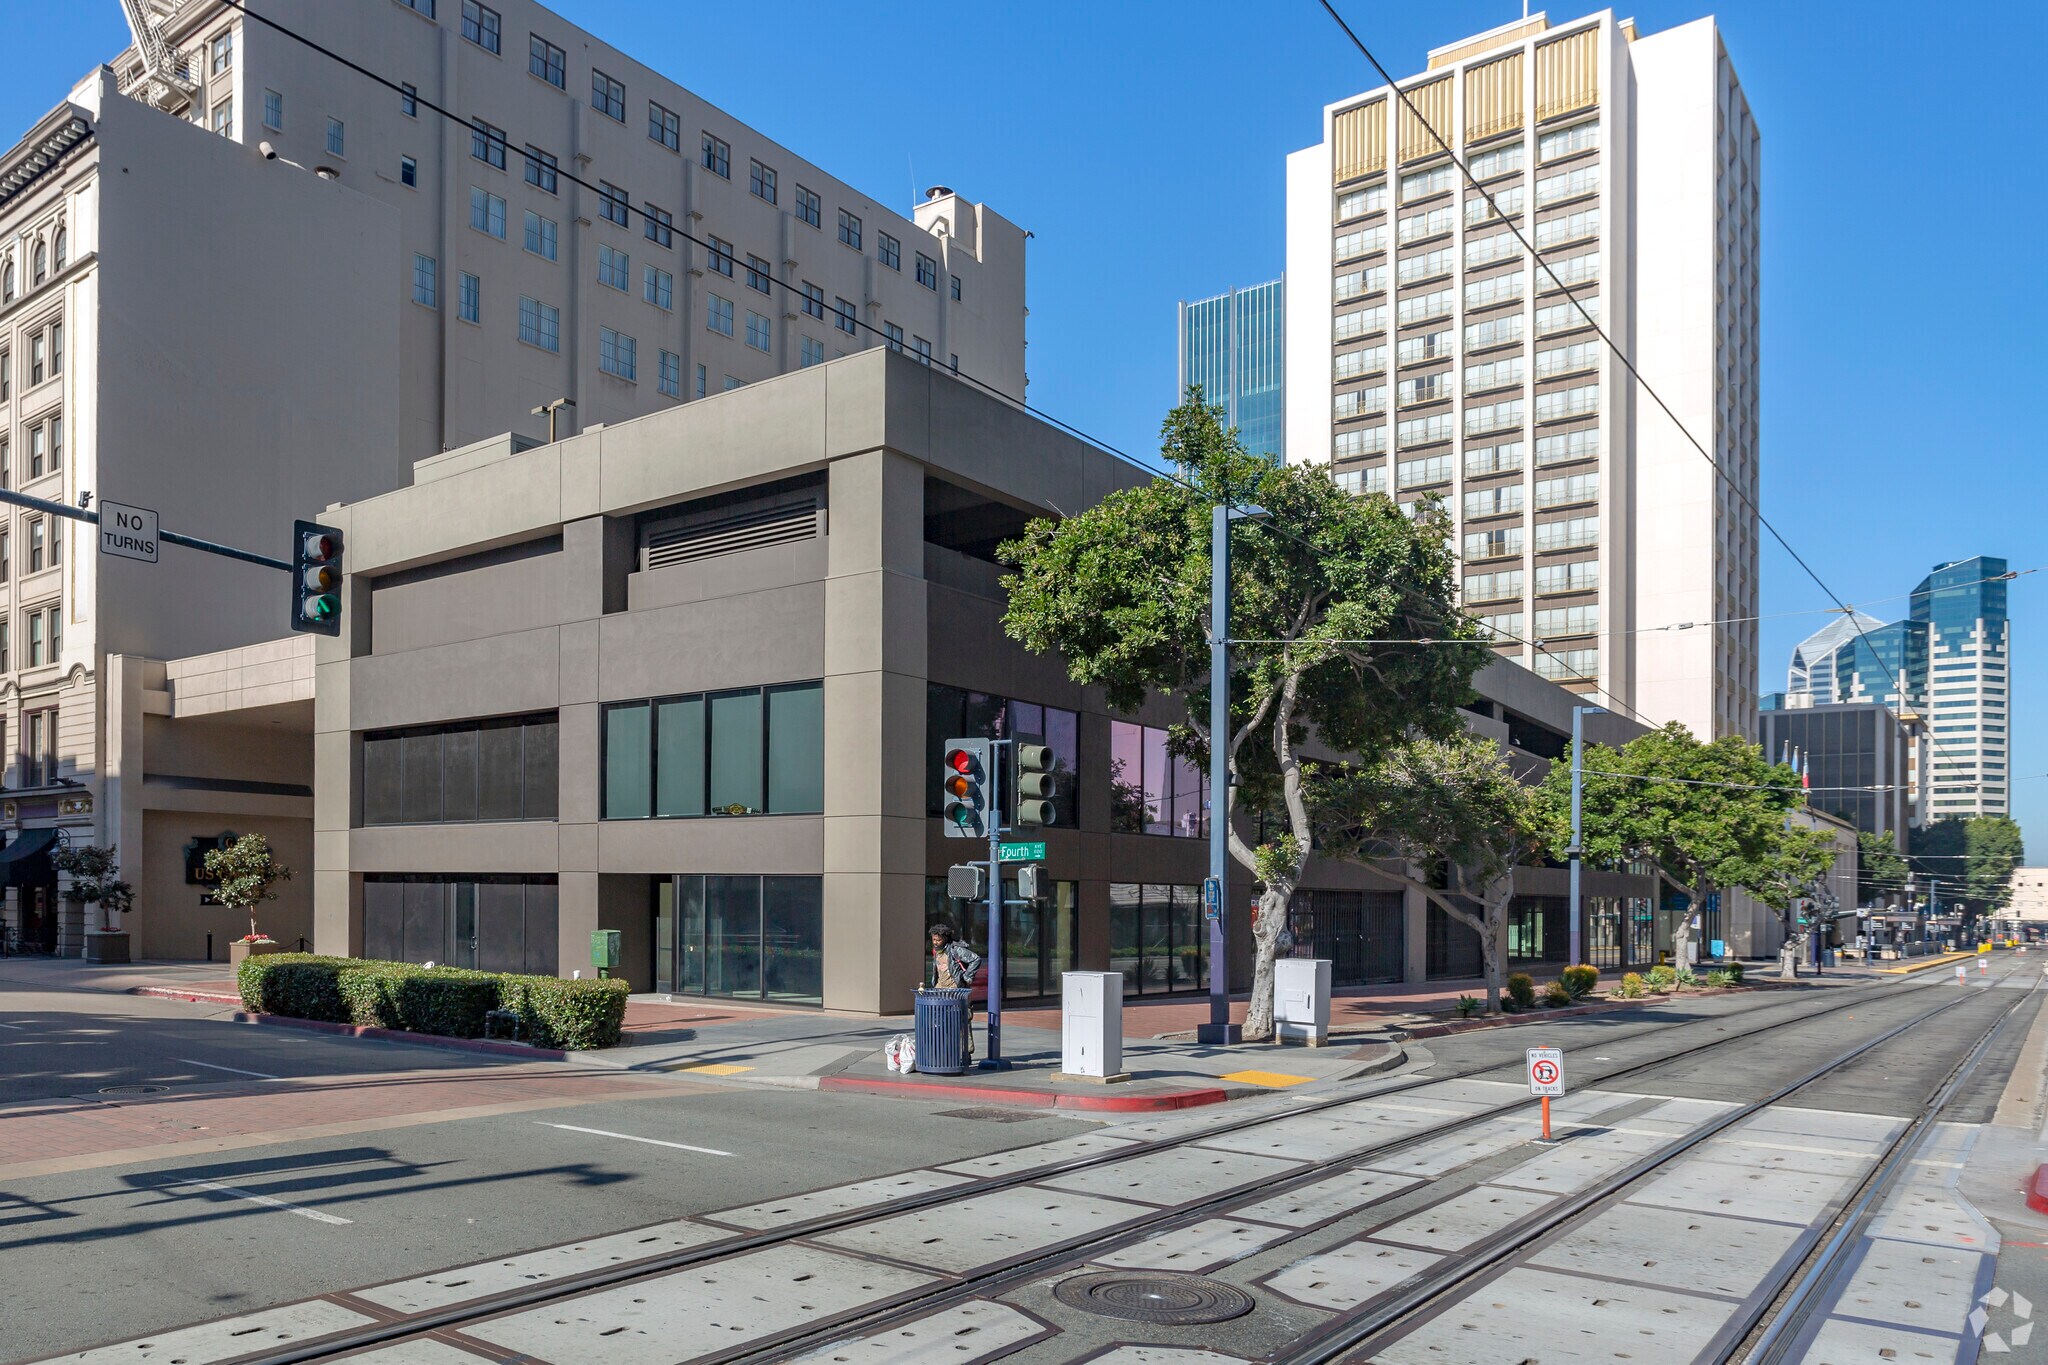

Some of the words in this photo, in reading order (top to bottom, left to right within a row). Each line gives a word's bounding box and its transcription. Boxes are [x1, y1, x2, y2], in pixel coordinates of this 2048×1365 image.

[117, 512, 143, 531] NO
[104, 532, 154, 554] TURNS
[1001, 846, 1029, 858] Fourth
